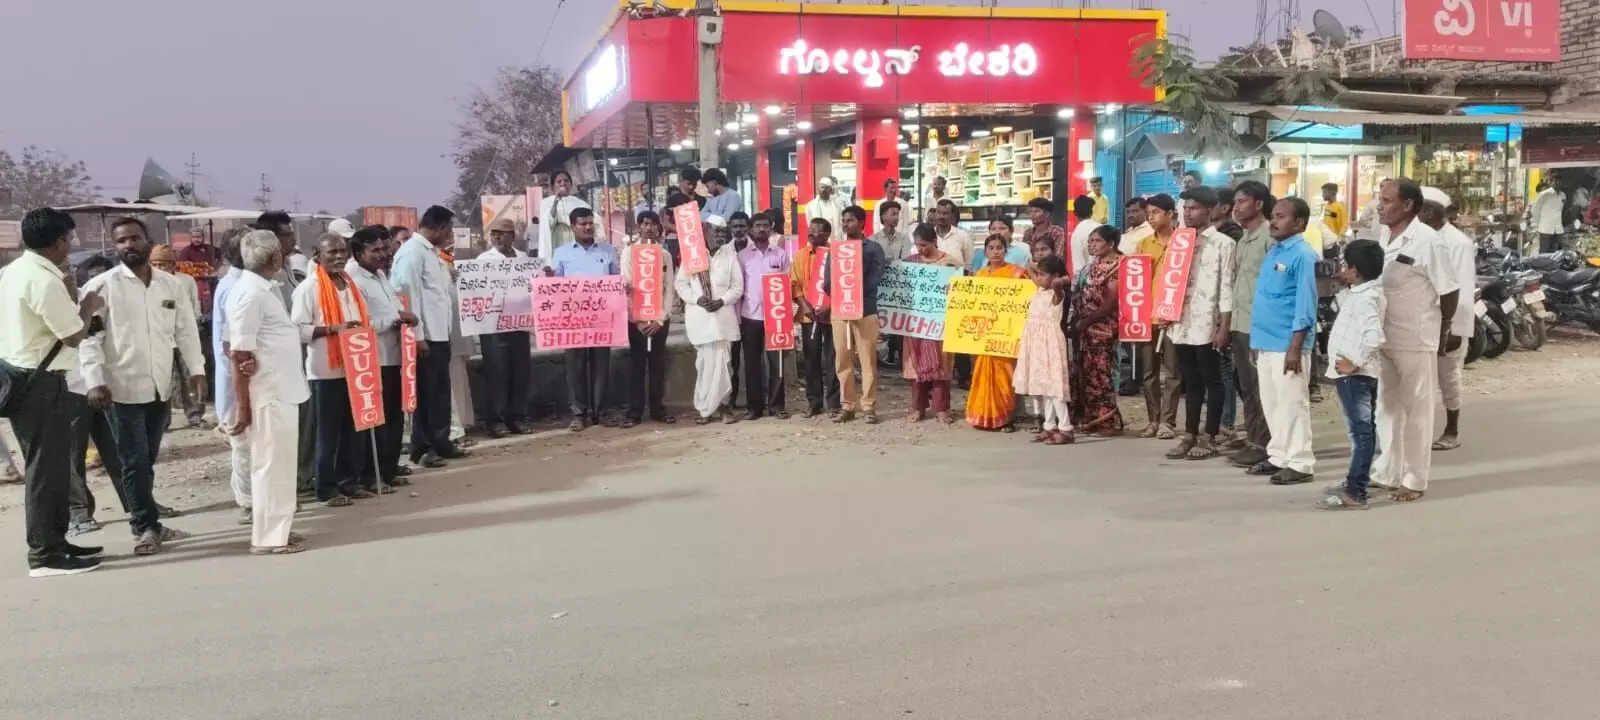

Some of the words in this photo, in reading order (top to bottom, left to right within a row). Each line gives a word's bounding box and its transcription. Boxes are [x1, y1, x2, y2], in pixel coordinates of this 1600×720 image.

[937, 42, 1038, 77] ಬೇಕರಿ
[679, 207, 704, 260] SUCI
[638, 248, 656, 306] SUCI
[838, 243, 855, 302] SUCI
[1126, 258, 1145, 321] SUCI
[1163, 232, 1190, 305] SUCI
[769, 277, 786, 332] SUCI
[348, 333, 376, 410] SUCI
